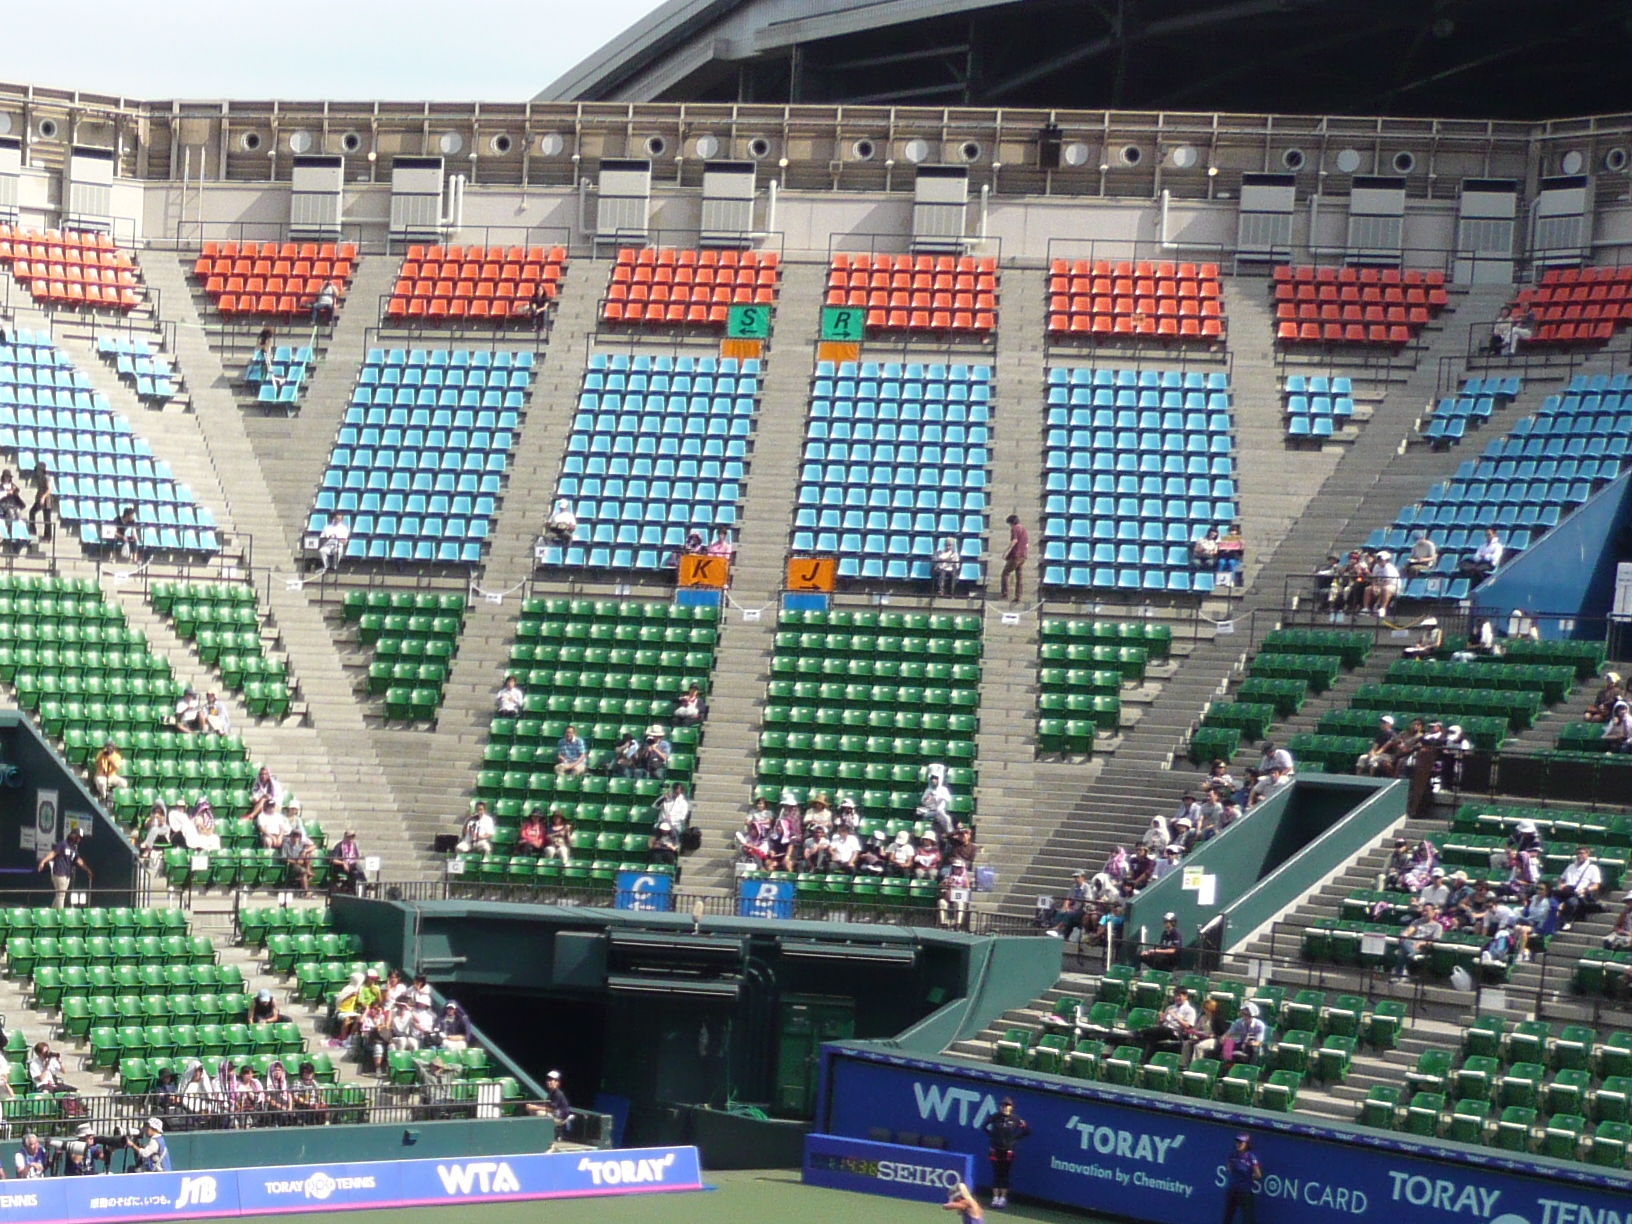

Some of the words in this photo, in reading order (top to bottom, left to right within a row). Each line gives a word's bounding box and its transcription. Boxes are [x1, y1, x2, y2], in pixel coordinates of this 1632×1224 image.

[740, 308, 757, 327] S
[834, 311, 851, 329] R
[692, 560, 713, 579] K
[801, 562, 820, 582] J
[633, 877, 656, 900] C
[756, 882, 780, 906] B
[265, 1180, 304, 1195] TORAY
[336, 1175, 376, 1191] TENNIS
[437, 1162, 521, 1196] WTA
[877, 1160, 962, 1189] SEIKO
[1051, 1155, 1113, 1181] Innovation
[1114, 1170, 1131, 1186] by
[1133, 1171, 1193, 1197] Chemistry
[174, 1175, 217, 1210] JTB
[1214, 1164, 1300, 1200] SSON
[1303, 1181, 1368, 1216] CARD
[1387, 1170, 1502, 1219] TORAY
